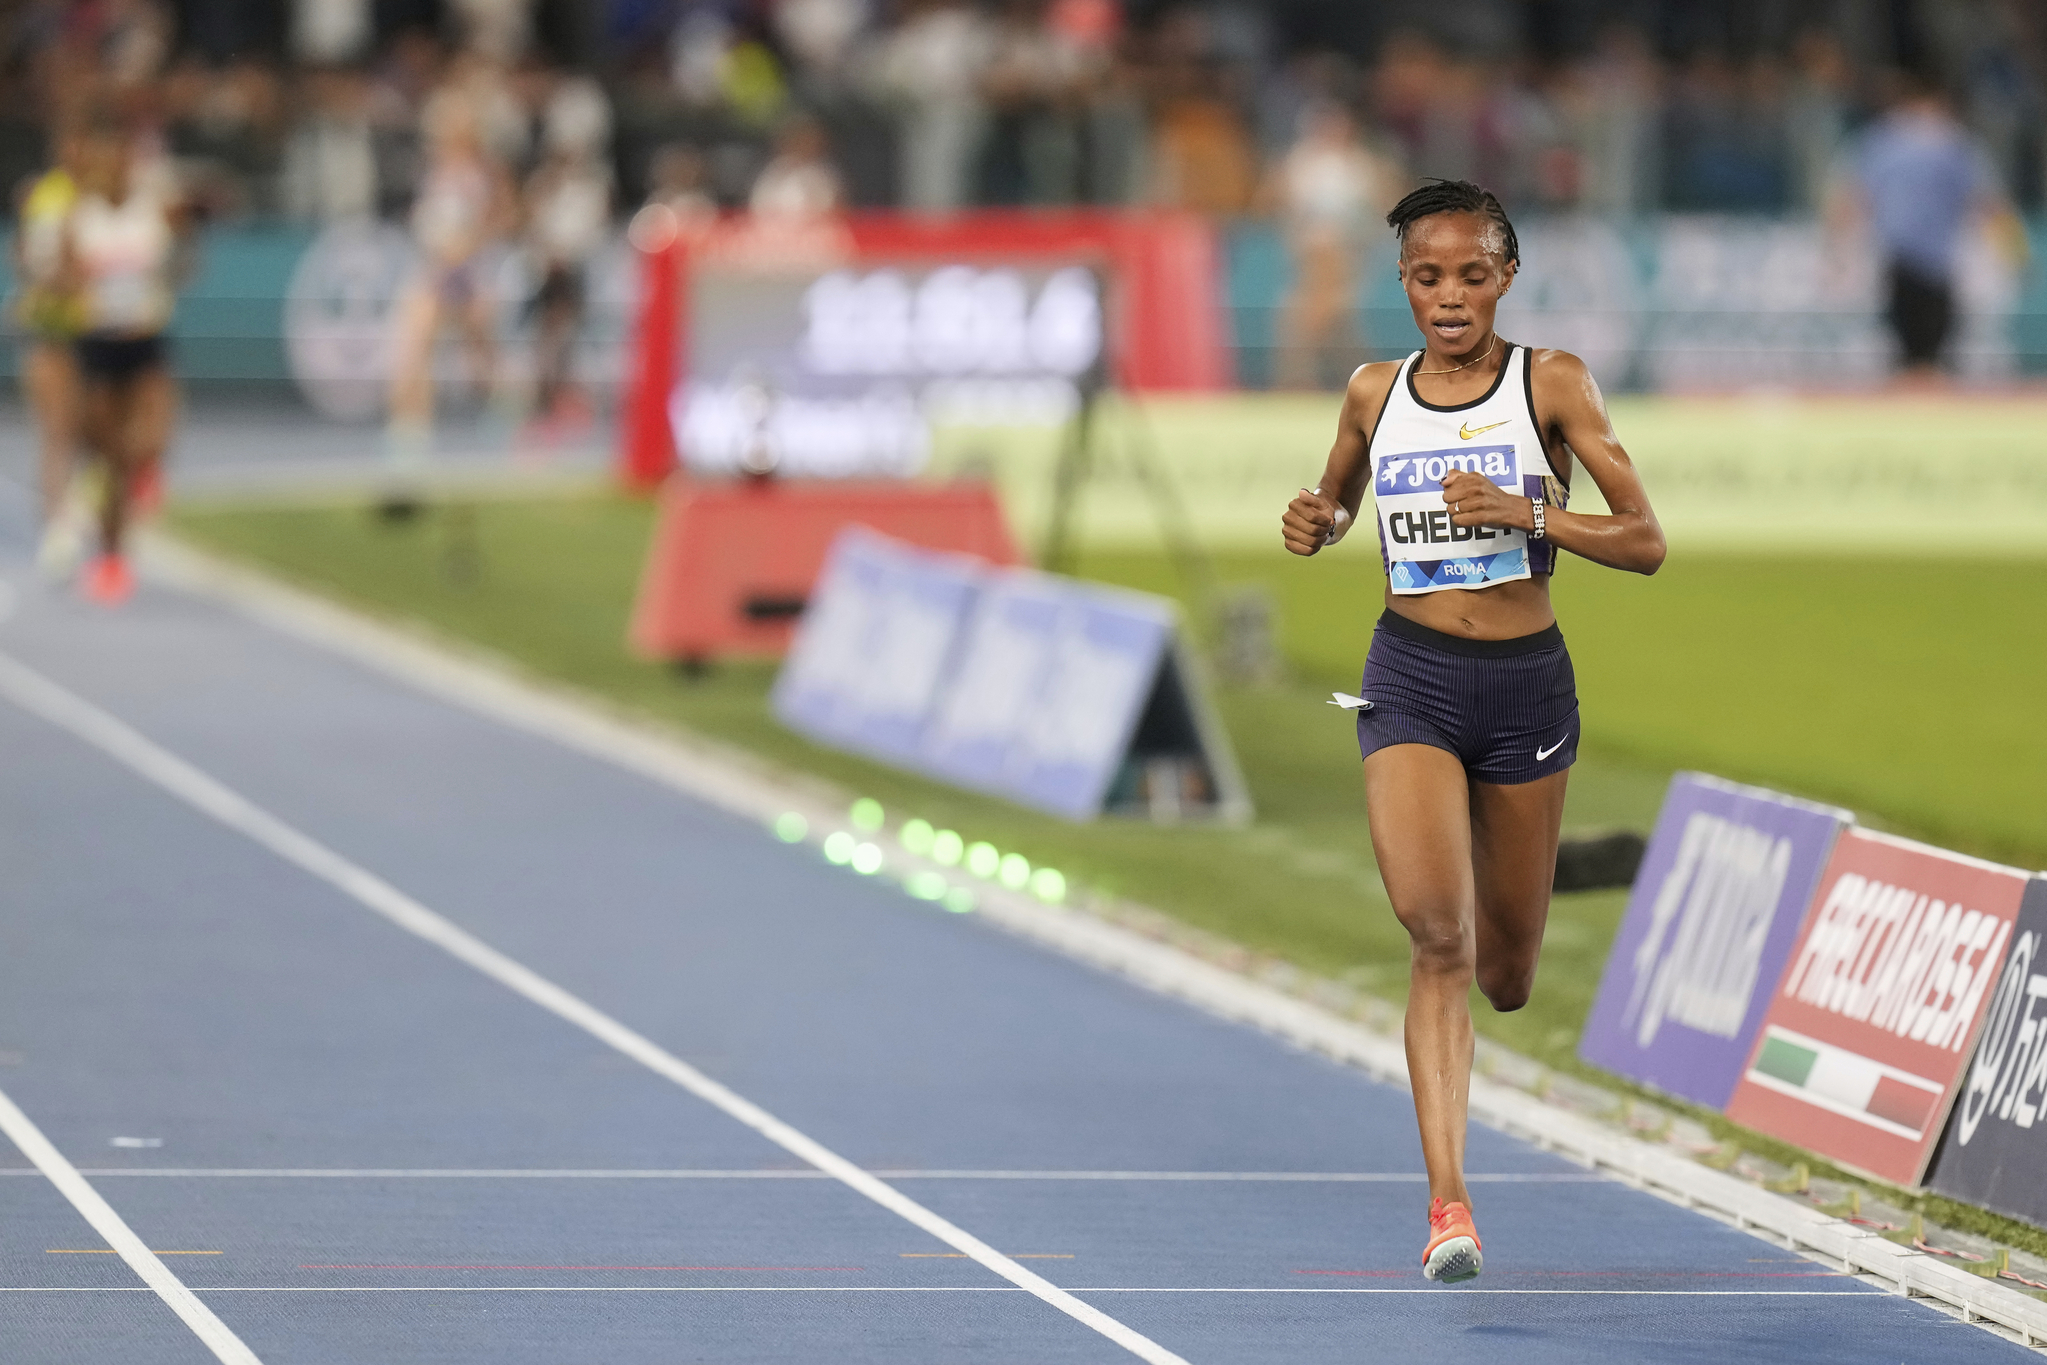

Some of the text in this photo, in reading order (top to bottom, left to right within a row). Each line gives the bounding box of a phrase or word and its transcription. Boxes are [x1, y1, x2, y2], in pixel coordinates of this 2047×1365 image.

[1389, 510, 1512, 543] CHEB
[1444, 562, 1487, 576] ROMA
[1783, 872, 2011, 1053] FRECCIAROSSA
